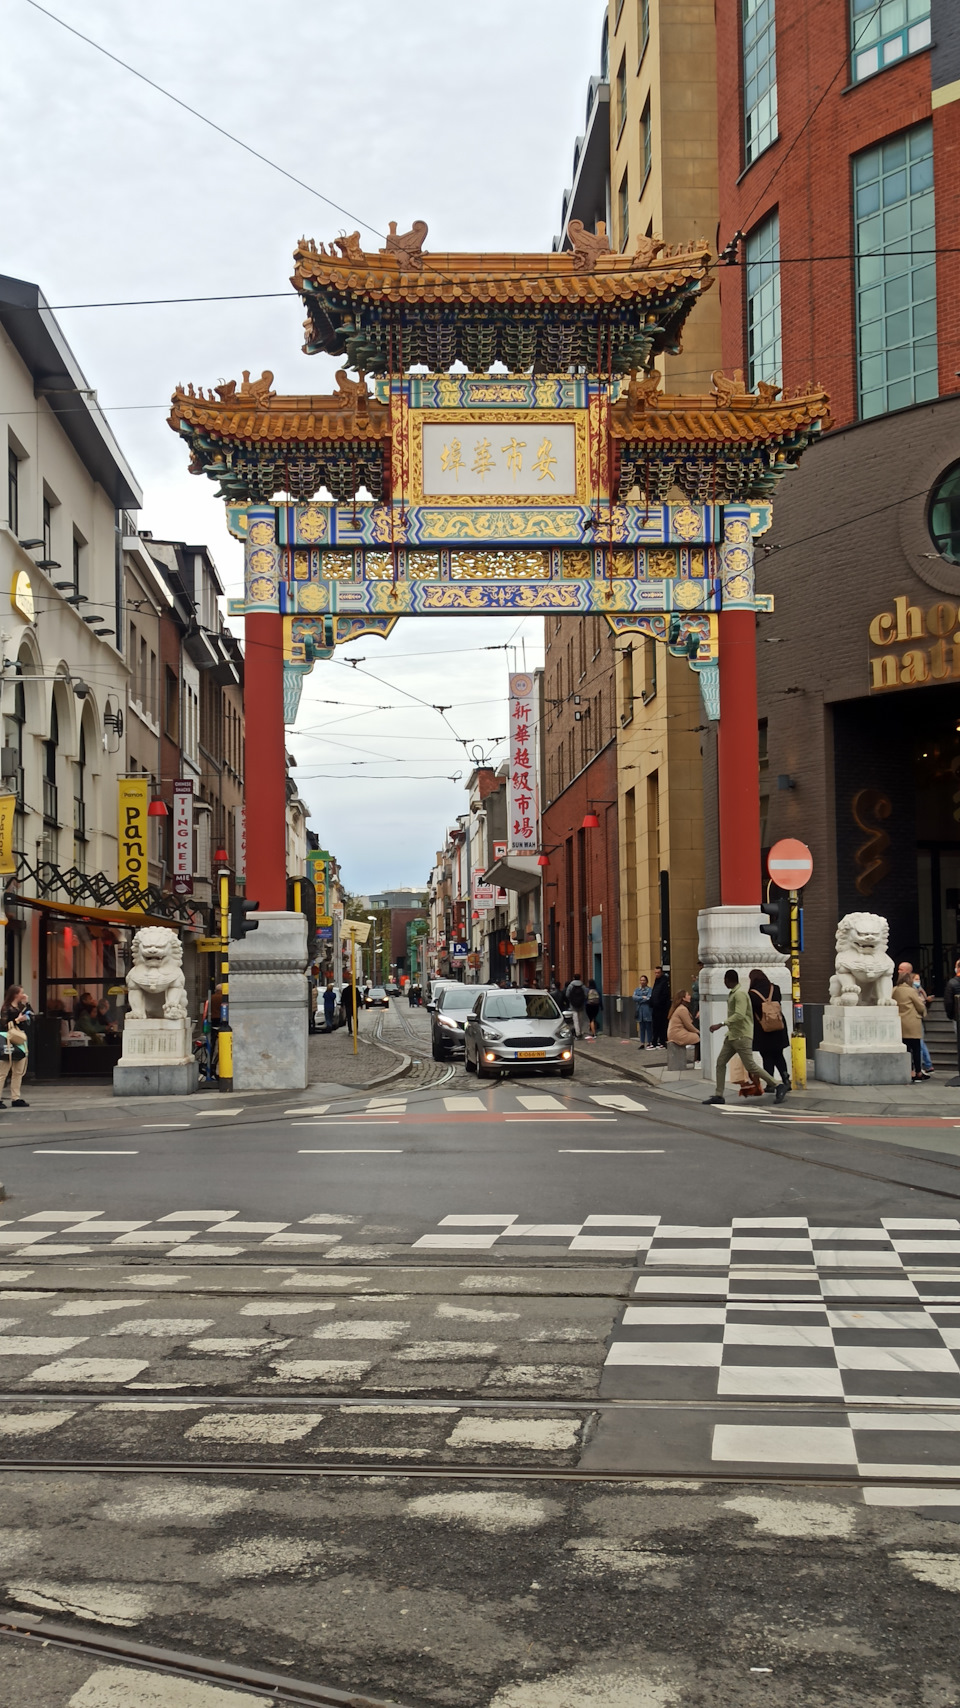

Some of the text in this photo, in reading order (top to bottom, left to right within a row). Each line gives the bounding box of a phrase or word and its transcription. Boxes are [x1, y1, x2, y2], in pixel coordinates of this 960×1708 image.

[869, 595, 960, 646] cho
[511, 701, 534, 839] 新華超級市場
